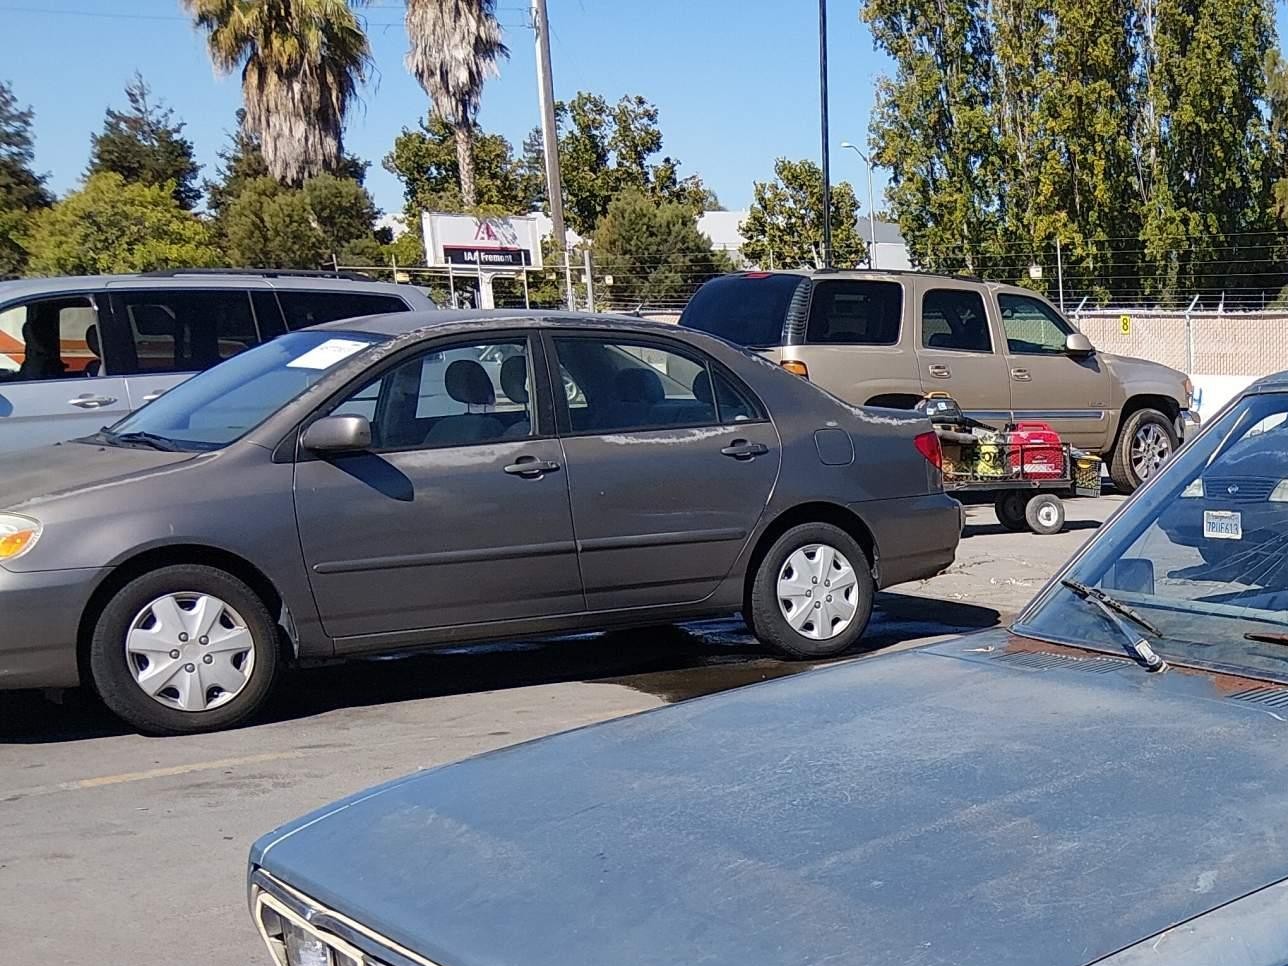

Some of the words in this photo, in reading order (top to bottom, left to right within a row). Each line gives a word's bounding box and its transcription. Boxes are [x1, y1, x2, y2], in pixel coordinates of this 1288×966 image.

[463, 251, 478, 261] IAA
[481, 252, 512, 262] Fremont
[1122, 317, 1129, 331] 8
